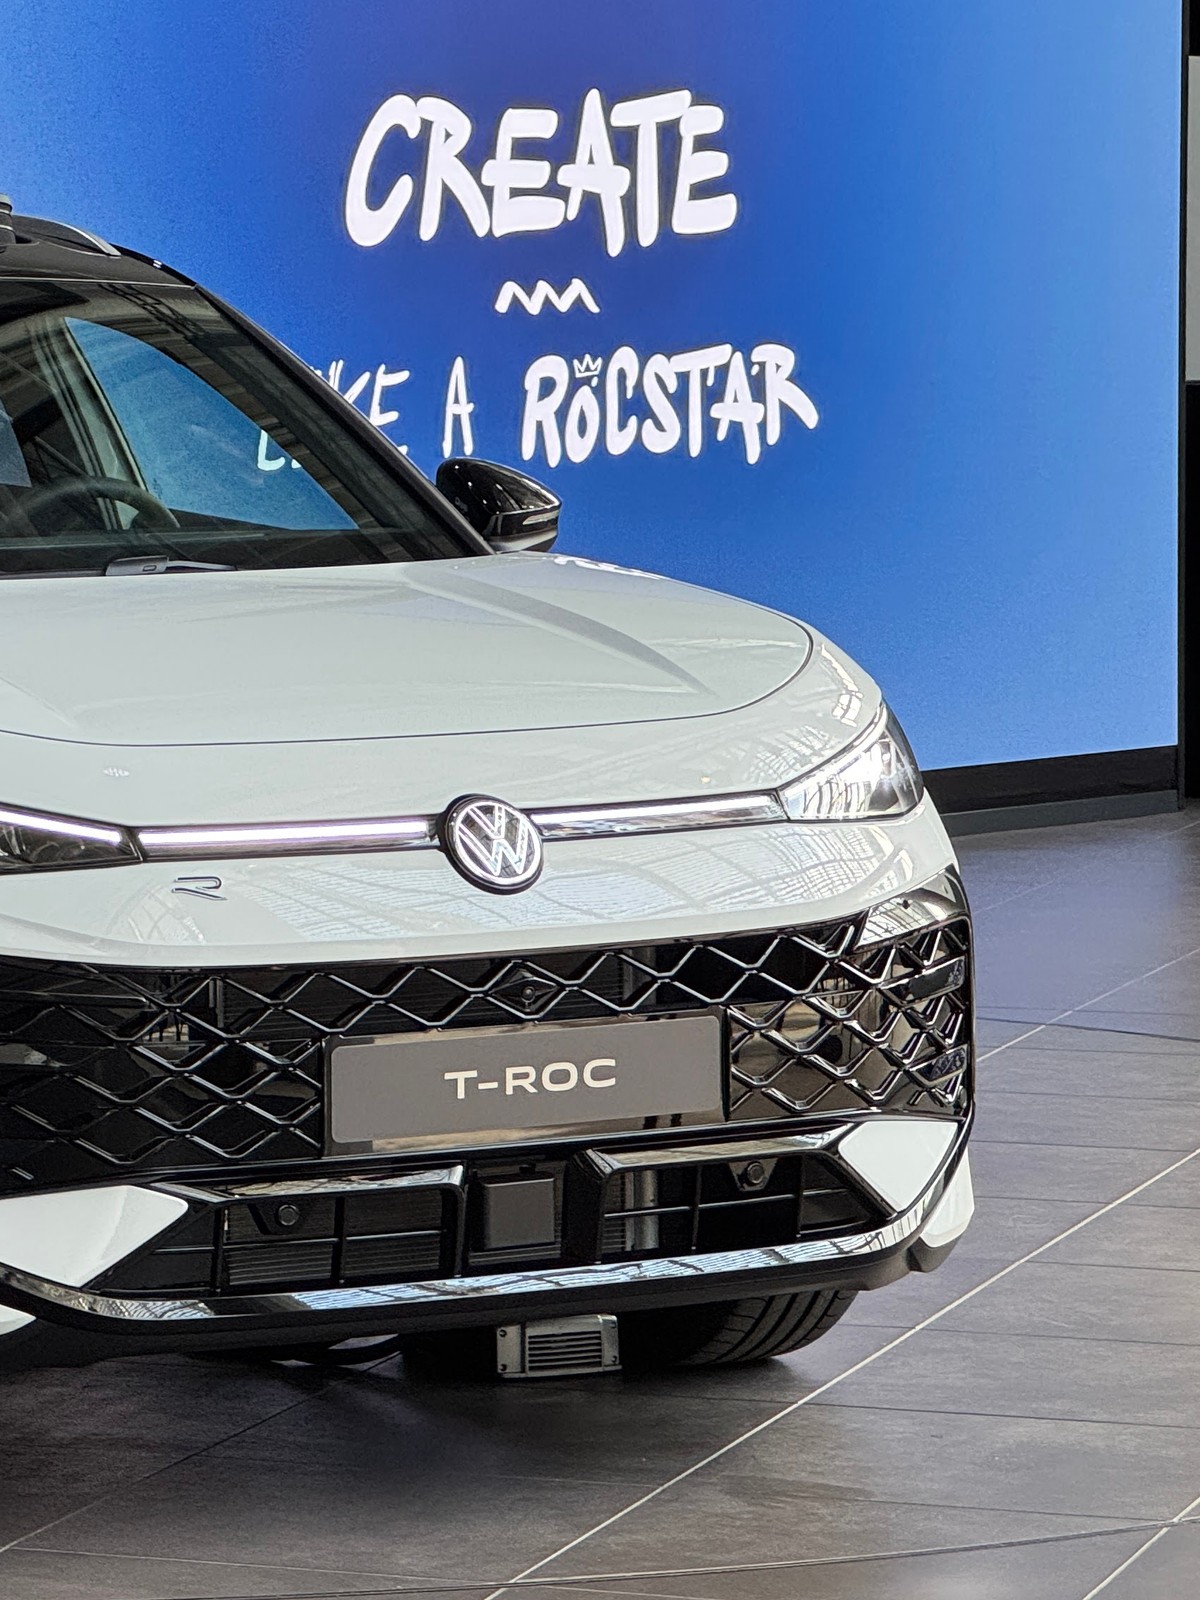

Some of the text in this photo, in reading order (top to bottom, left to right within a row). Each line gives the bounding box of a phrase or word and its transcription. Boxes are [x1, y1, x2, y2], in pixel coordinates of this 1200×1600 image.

[345, 87, 738, 258] CREATE
[442, 355, 476, 459] A
[443, 1058, 616, 1100] T-ROC
